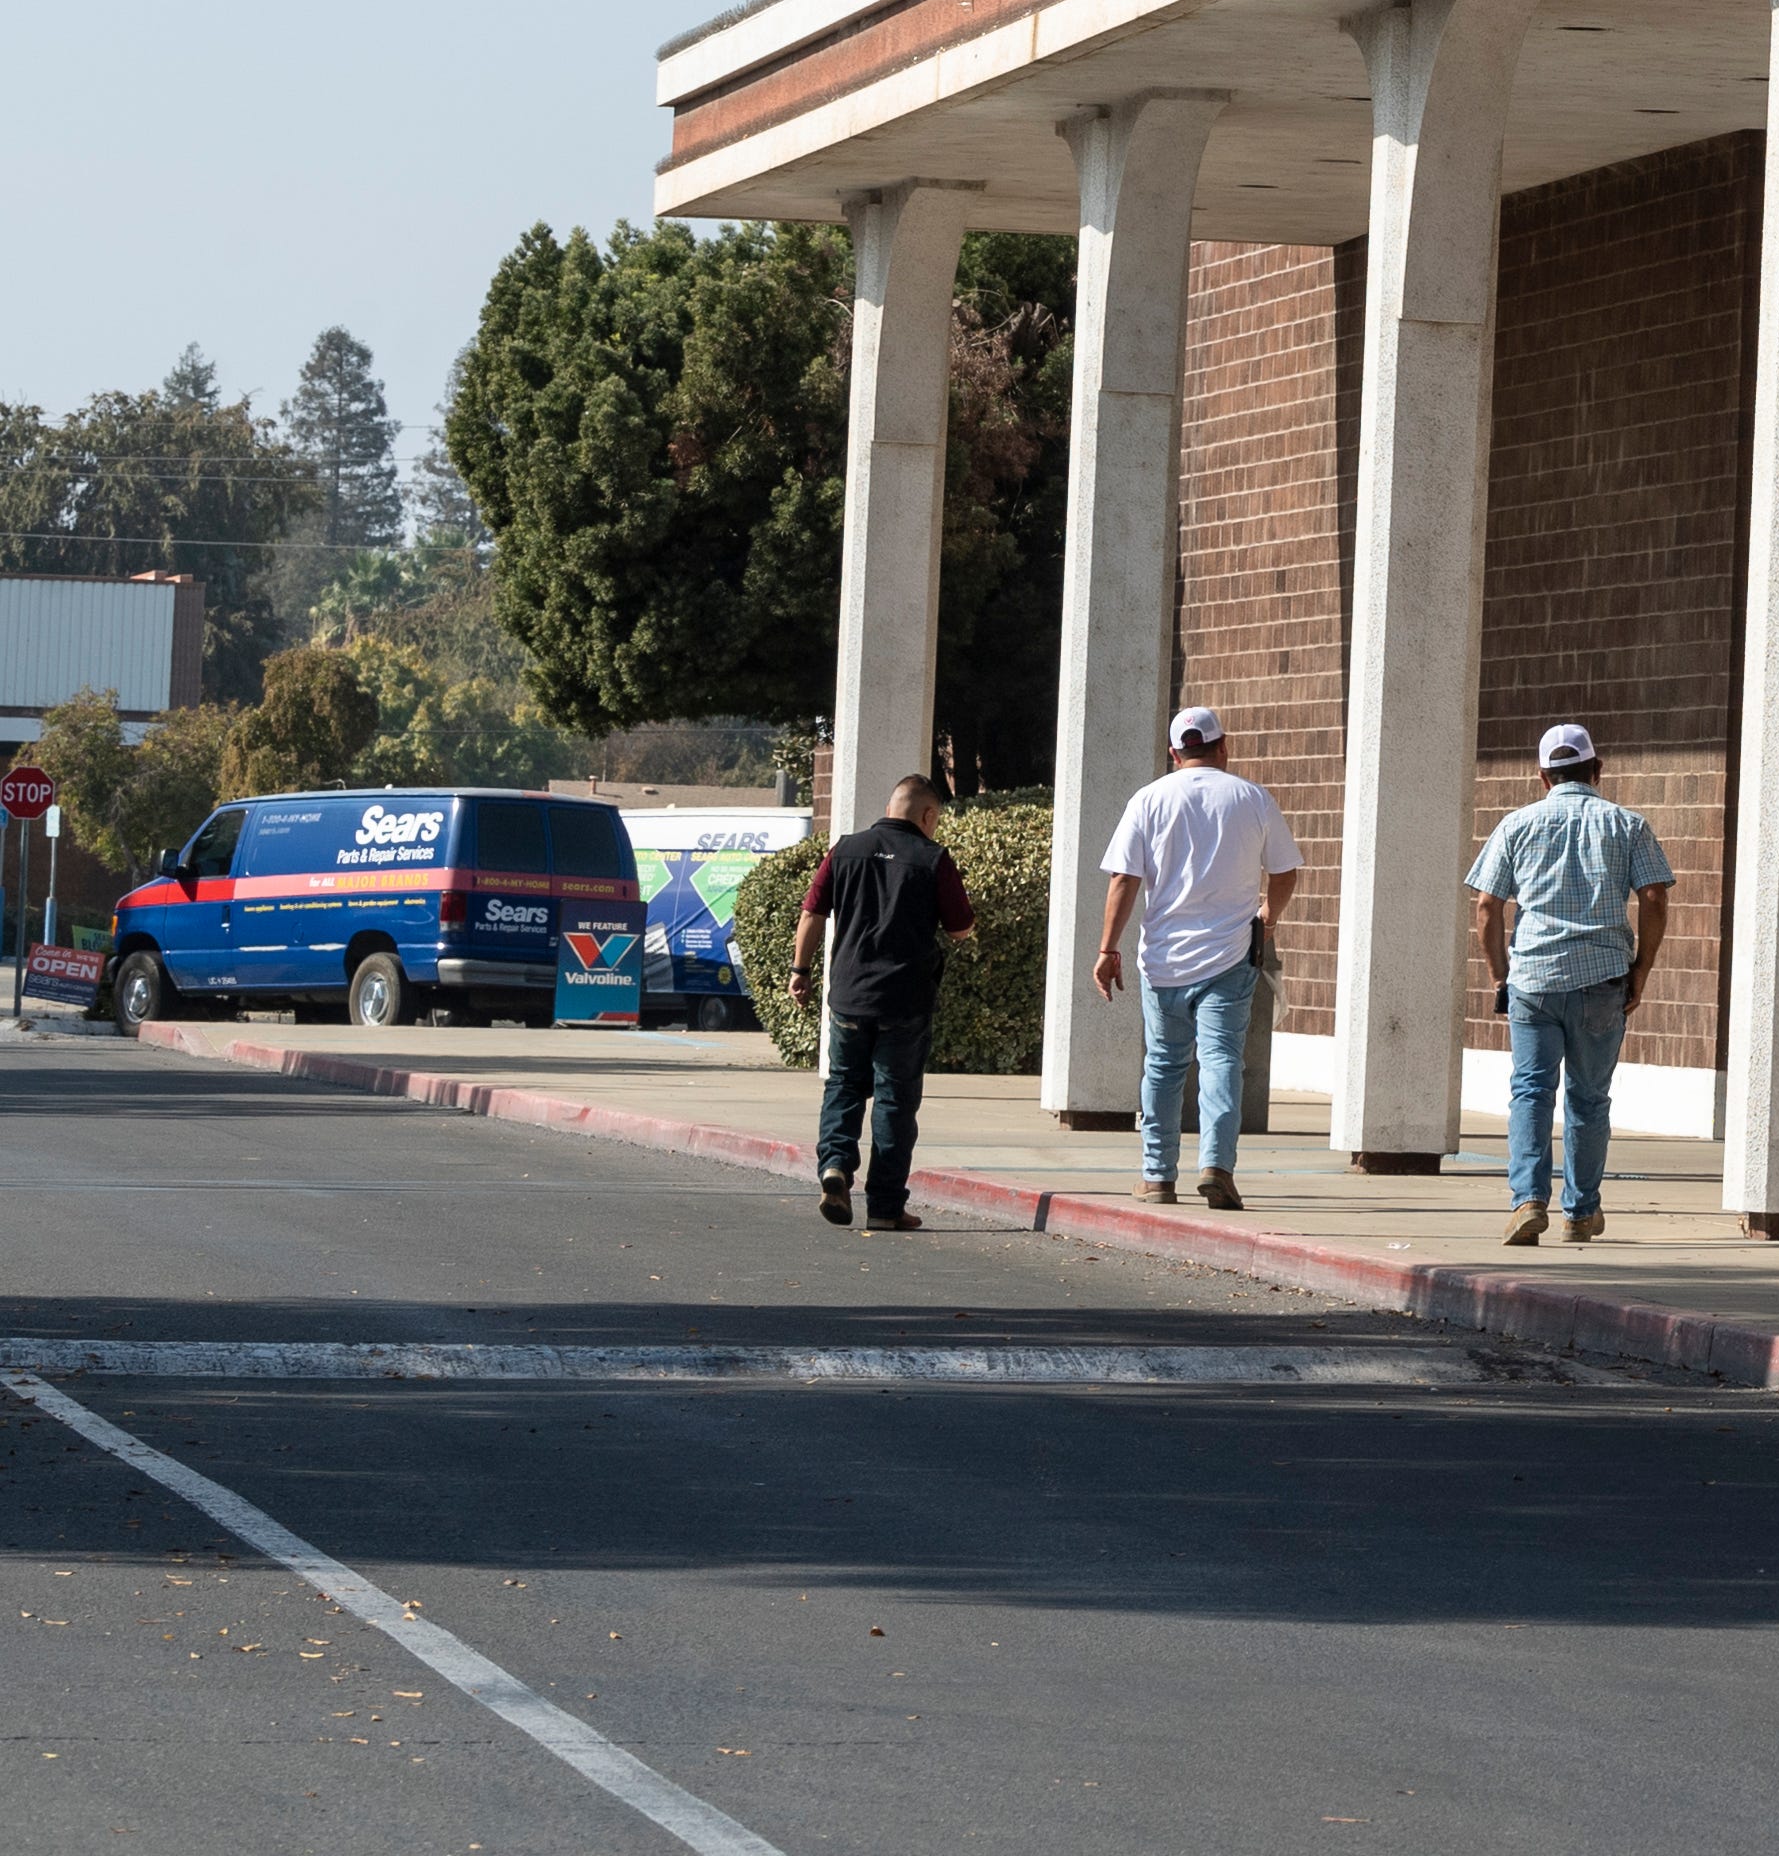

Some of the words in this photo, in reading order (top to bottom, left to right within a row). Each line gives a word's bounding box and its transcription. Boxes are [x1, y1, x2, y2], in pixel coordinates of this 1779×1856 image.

[3, 782, 52, 802] STOP
[355, 805, 444, 845] Sears
[696, 832, 769, 851] SEARS
[336, 848, 360, 864] Parts
[360, 848, 368, 862] &
[368, 847, 397, 865] Repair
[397, 845, 434, 861] Services
[337, 875, 376, 888] MAJOR
[380, 873, 429, 888] BRANDS
[562, 882, 615, 893] sears.com
[485, 899, 549, 924] Sears
[474, 922, 493, 931] Parts
[499, 923, 520, 933] Repair
[520, 924, 547, 934] Services
[578, 922, 591, 930] WE
[593, 922, 628, 931] FEATURE
[32, 956, 97, 980] OPEN
[564, 972, 632, 986] Valvoline
